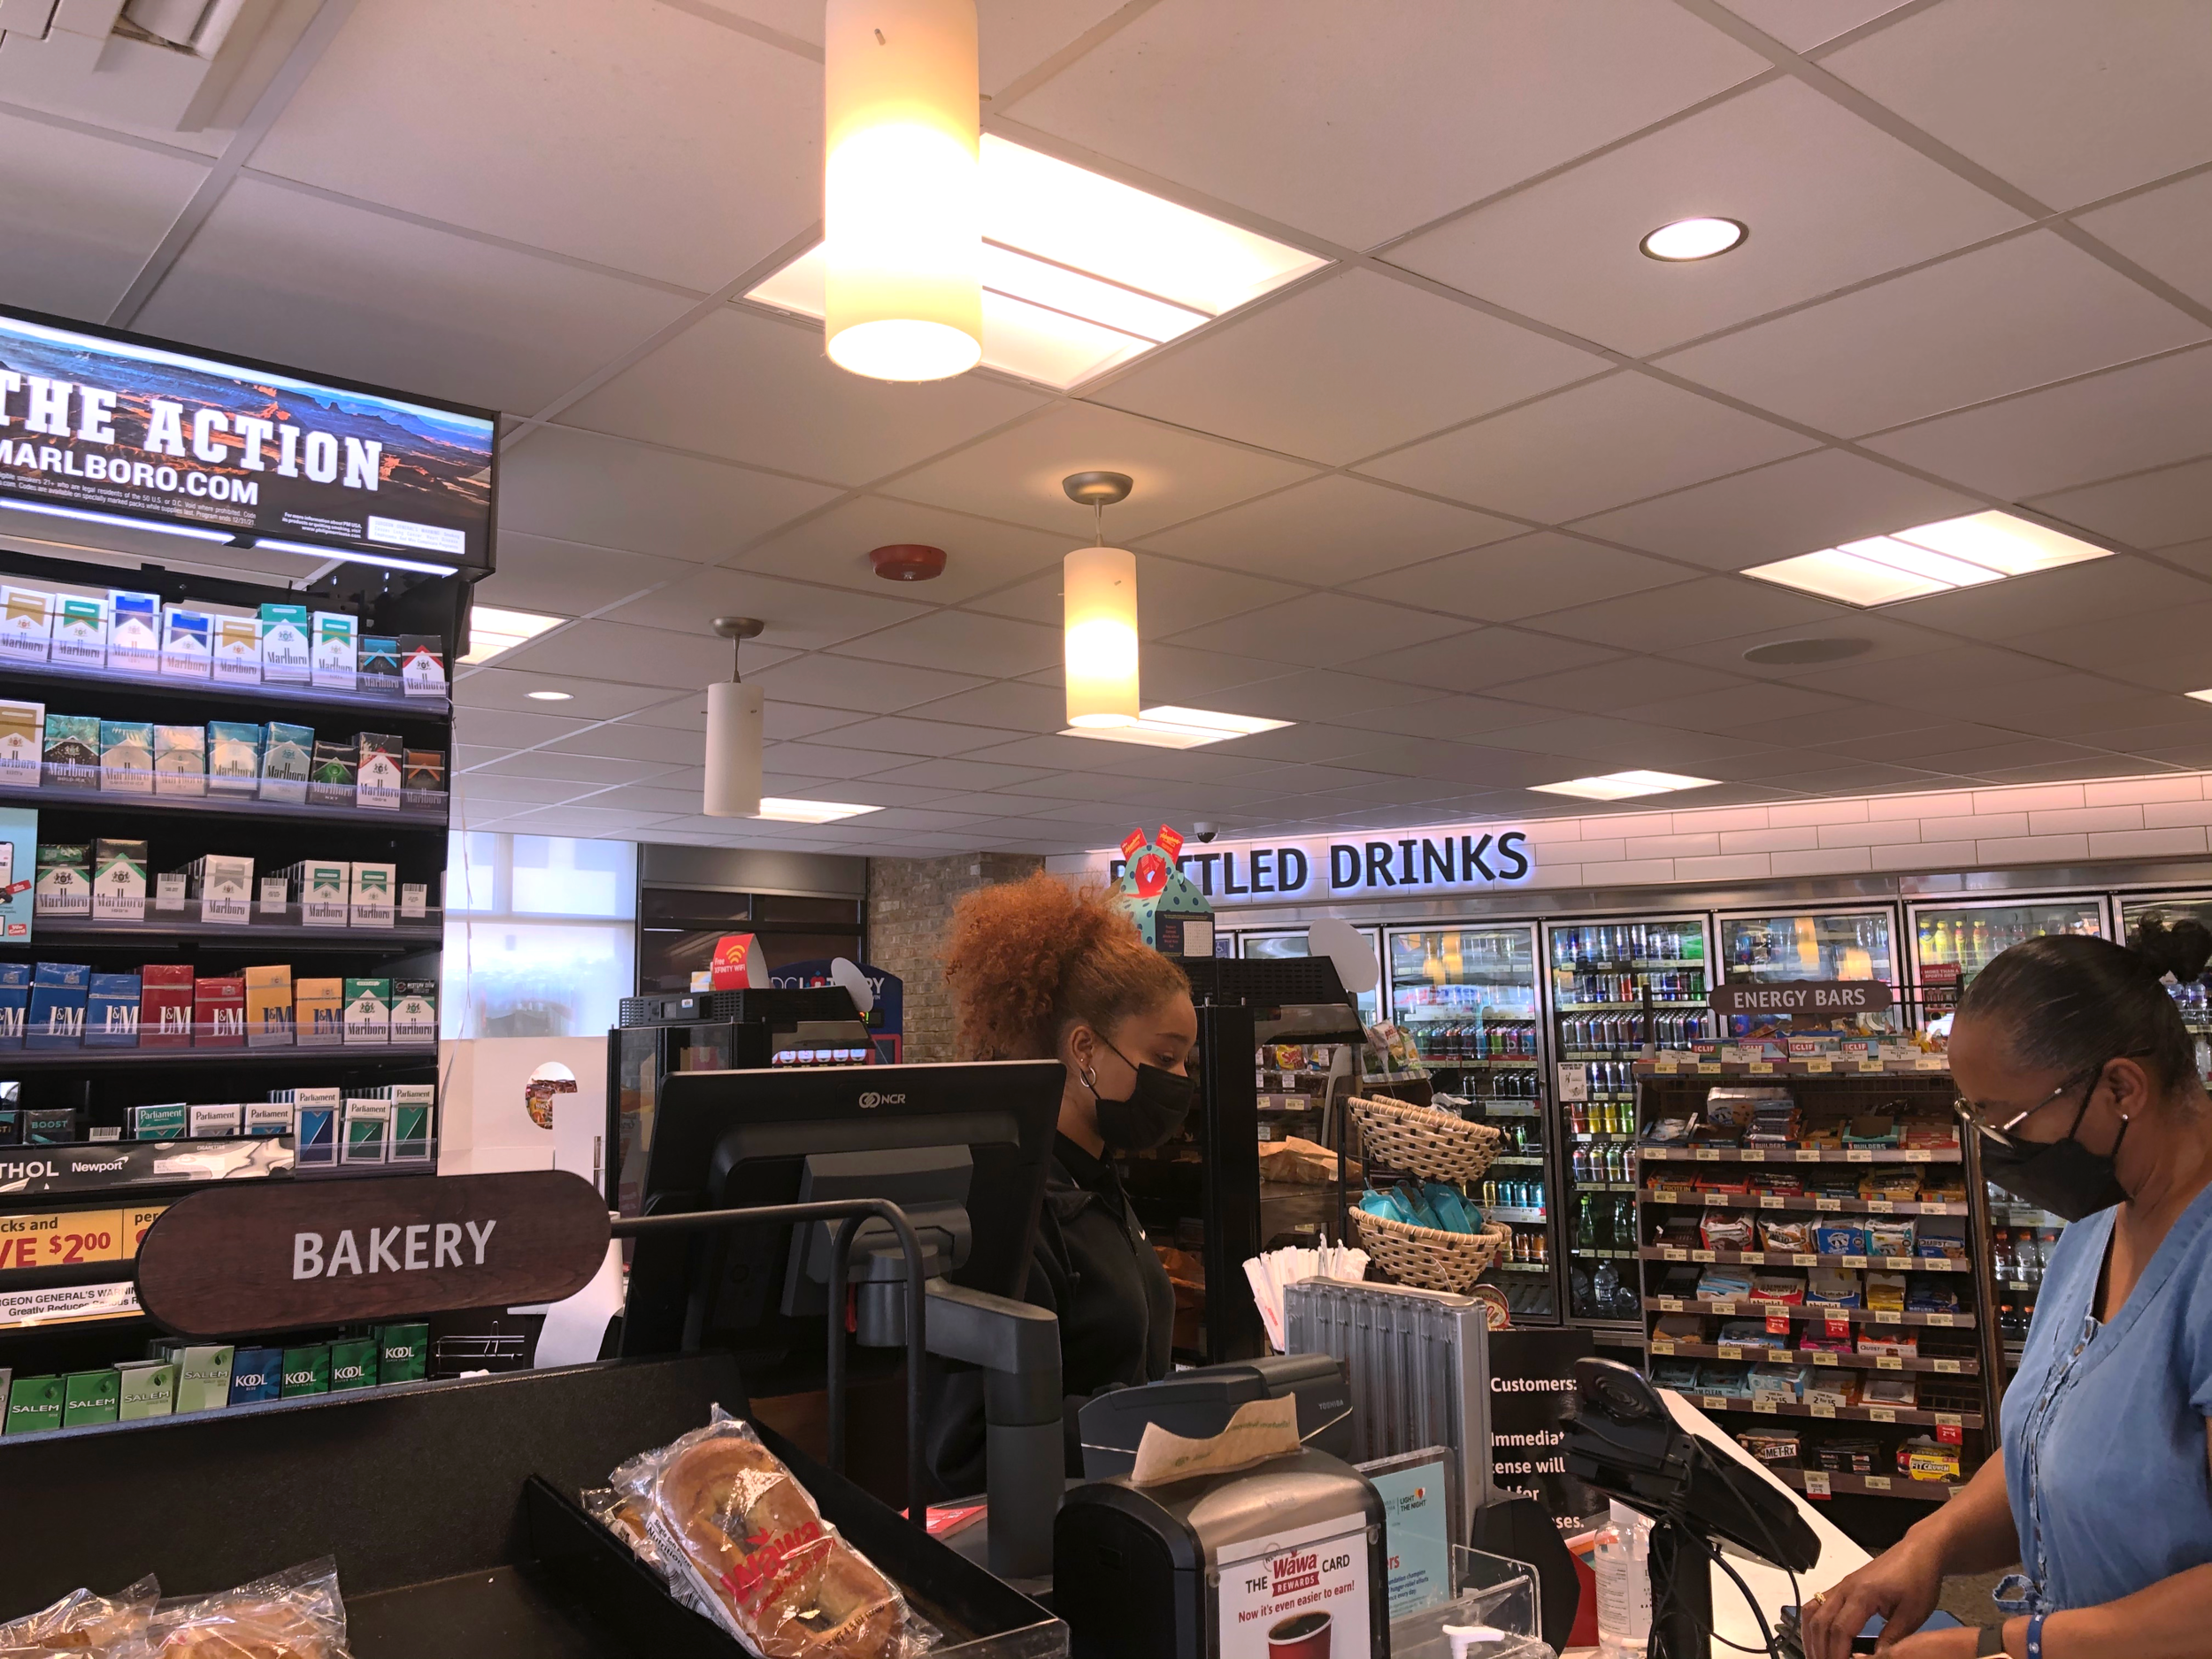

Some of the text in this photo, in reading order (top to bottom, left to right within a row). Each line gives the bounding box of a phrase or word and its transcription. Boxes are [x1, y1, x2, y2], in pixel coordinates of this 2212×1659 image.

[143, 398, 383, 492] ACTION
[18, 482, 37, 491] Codes
[196, 510, 219, 519] Program
[97, 488, 122, 497] residents
[242, 511, 257, 519] Code
[1, 632, 43, 652] Marlboro
[58, 639, 100, 658] Marlboro
[167, 654, 208, 672] Marlboro
[267, 648, 307, 665] Marlboro
[319, 657, 353, 673] Marlboro
[220, 657, 257, 675] Marlboro
[407, 673, 445, 691] Marlboro
[48, 758, 95, 778] Marlboro
[105, 763, 150, 781] Marlboro
[215, 760, 255, 780] Marlboro
[267, 763, 306, 780] Marlboro
[313, 777, 353, 797] Marlboro
[360, 780, 399, 798] Marlboro
[406, 787, 442, 804] Marlboro
[1332, 832, 1529, 888] DRINKS
[38, 887, 88, 908] Marlboro
[96, 887, 143, 908] Marlboro
[209, 897, 245, 916] Marlboro
[309, 902, 343, 918] Marlboro
[357, 903, 390, 919] Marlboro
[714, 965, 733, 974] XFINITY
[1734, 989, 1865, 1009] ENERGY BARS
[47, 1006, 85, 1037] L&M
[104, 1005, 140, 1035] L&M
[158, 1006, 192, 1035] L&M
[213, 1007, 244, 1036] L&M
[263, 1006, 292, 1034] L&M
[313, 1009, 342, 1035] L&M
[348, 1018, 386, 1035] Marlboro
[395, 1018, 433, 1035] Marlboro
[299, 1092, 336, 1102] Parliament
[397, 1089, 430, 1100] Parliament
[881, 1094, 906, 1104] NCR
[140, 1110, 183, 1120] Parliament
[196, 1110, 234, 1121] Parliament
[251, 1109, 288, 1119] Parliament
[351, 1103, 386, 1114] Parliament
[31, 1120, 68, 1130] BOOST
[72, 1161, 123, 1173] Newport
[1, 1220, 26, 1233] cks
[30, 1217, 58, 1231] and
[293, 1219, 497, 1280] BAKERY
[0, 1296, 33, 1308] GEON
[35, 1290, 95, 1304] GENERAL'S
[385, 1347, 414, 1358] KOOL
[235, 1374, 267, 1386] KOOL
[285, 1371, 317, 1384] KOOL
[334, 1366, 365, 1379] KOOL
[1490, 1377, 1578, 1393] Customers:
[1751, 1378, 1780, 1390] ONE
[69, 1398, 115, 1409] SALEM
[124, 1391, 170, 1402] SALEM
[1318, 1400, 1344, 1409] TOSHIBA
[12, 1404, 59, 1413] SALEM
[1765, 1445, 1795, 1459] MET-Rx
[1536, 1457, 1565, 1473] will
[1400, 1495, 1415, 1505] LIGHT
[1401, 1503, 1410, 1512] THE
[1411, 1500, 1426, 1510] NIGHT
[1552, 1516, 1584, 1529] ses.
[655, 1519, 667, 1538] Single
[666, 1536, 677, 1549] Soft
[648, 1526, 682, 1567] Nutrition
[720, 1522, 820, 1606] Wawa
[1273, 1553, 1317, 1579] Wawa
[1246, 1554, 1350, 1594] THE REWARDS CARD
[1407, 1570, 1425, 1580] champion
[1239, 1579, 1355, 1623] Now it's even easier to earn!
[1397, 1590, 1409, 1600] every
